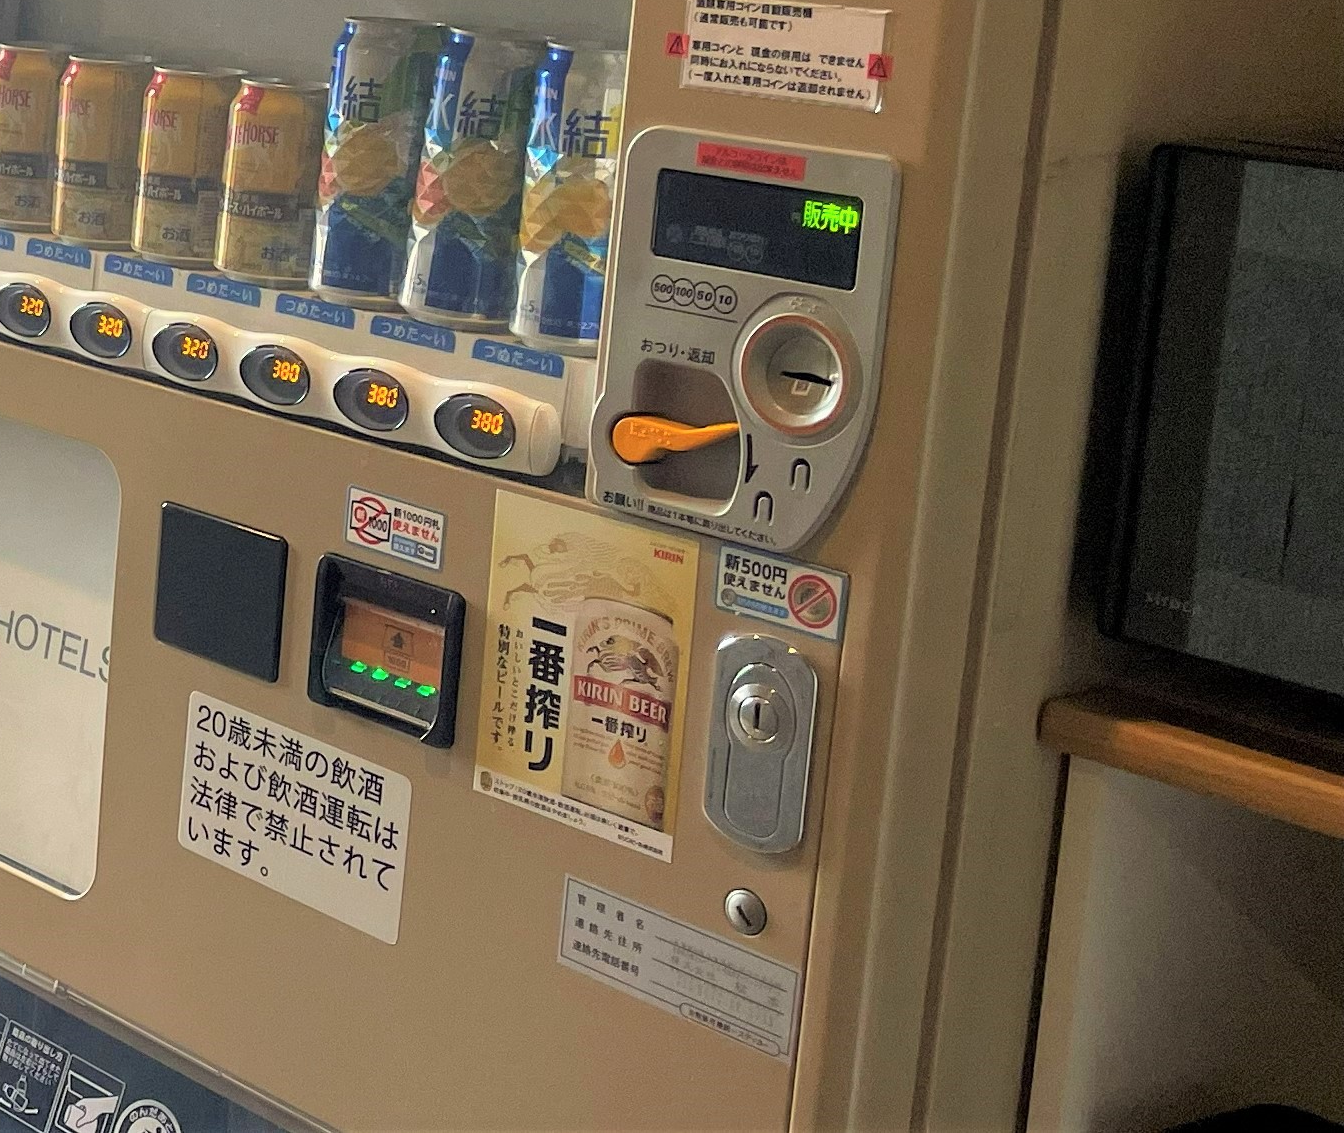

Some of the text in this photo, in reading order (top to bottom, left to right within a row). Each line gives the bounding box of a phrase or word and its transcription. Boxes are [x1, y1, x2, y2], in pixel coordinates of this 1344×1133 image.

[802, 200, 860, 235] 販売中
[20, 296, 43, 315] 320
[697, 290, 713, 302] 50
[719, 295, 733, 305] 10
[98, 316, 123, 337] 320
[182, 338, 208, 359] 320
[640, 338, 715, 365] おつり・返却
[272, 360, 300, 383] 380
[367, 384, 397, 407] 380
[471, 410, 502, 434] 380
[653, 548, 684, 564] KIRIN
[725, 553, 788, 585] 新500円
[724, 572, 785, 600] 使えません
[524, 615, 567, 773] 一番搾り
[578, 679, 667, 724] KIRIN BEER
[195, 705, 383, 806] 20歳未満の飲酒
[193, 740, 399, 851] および飲酒運転は
[187, 815, 270, 878] います。
[189, 776, 397, 891] 法律で禁止されて
